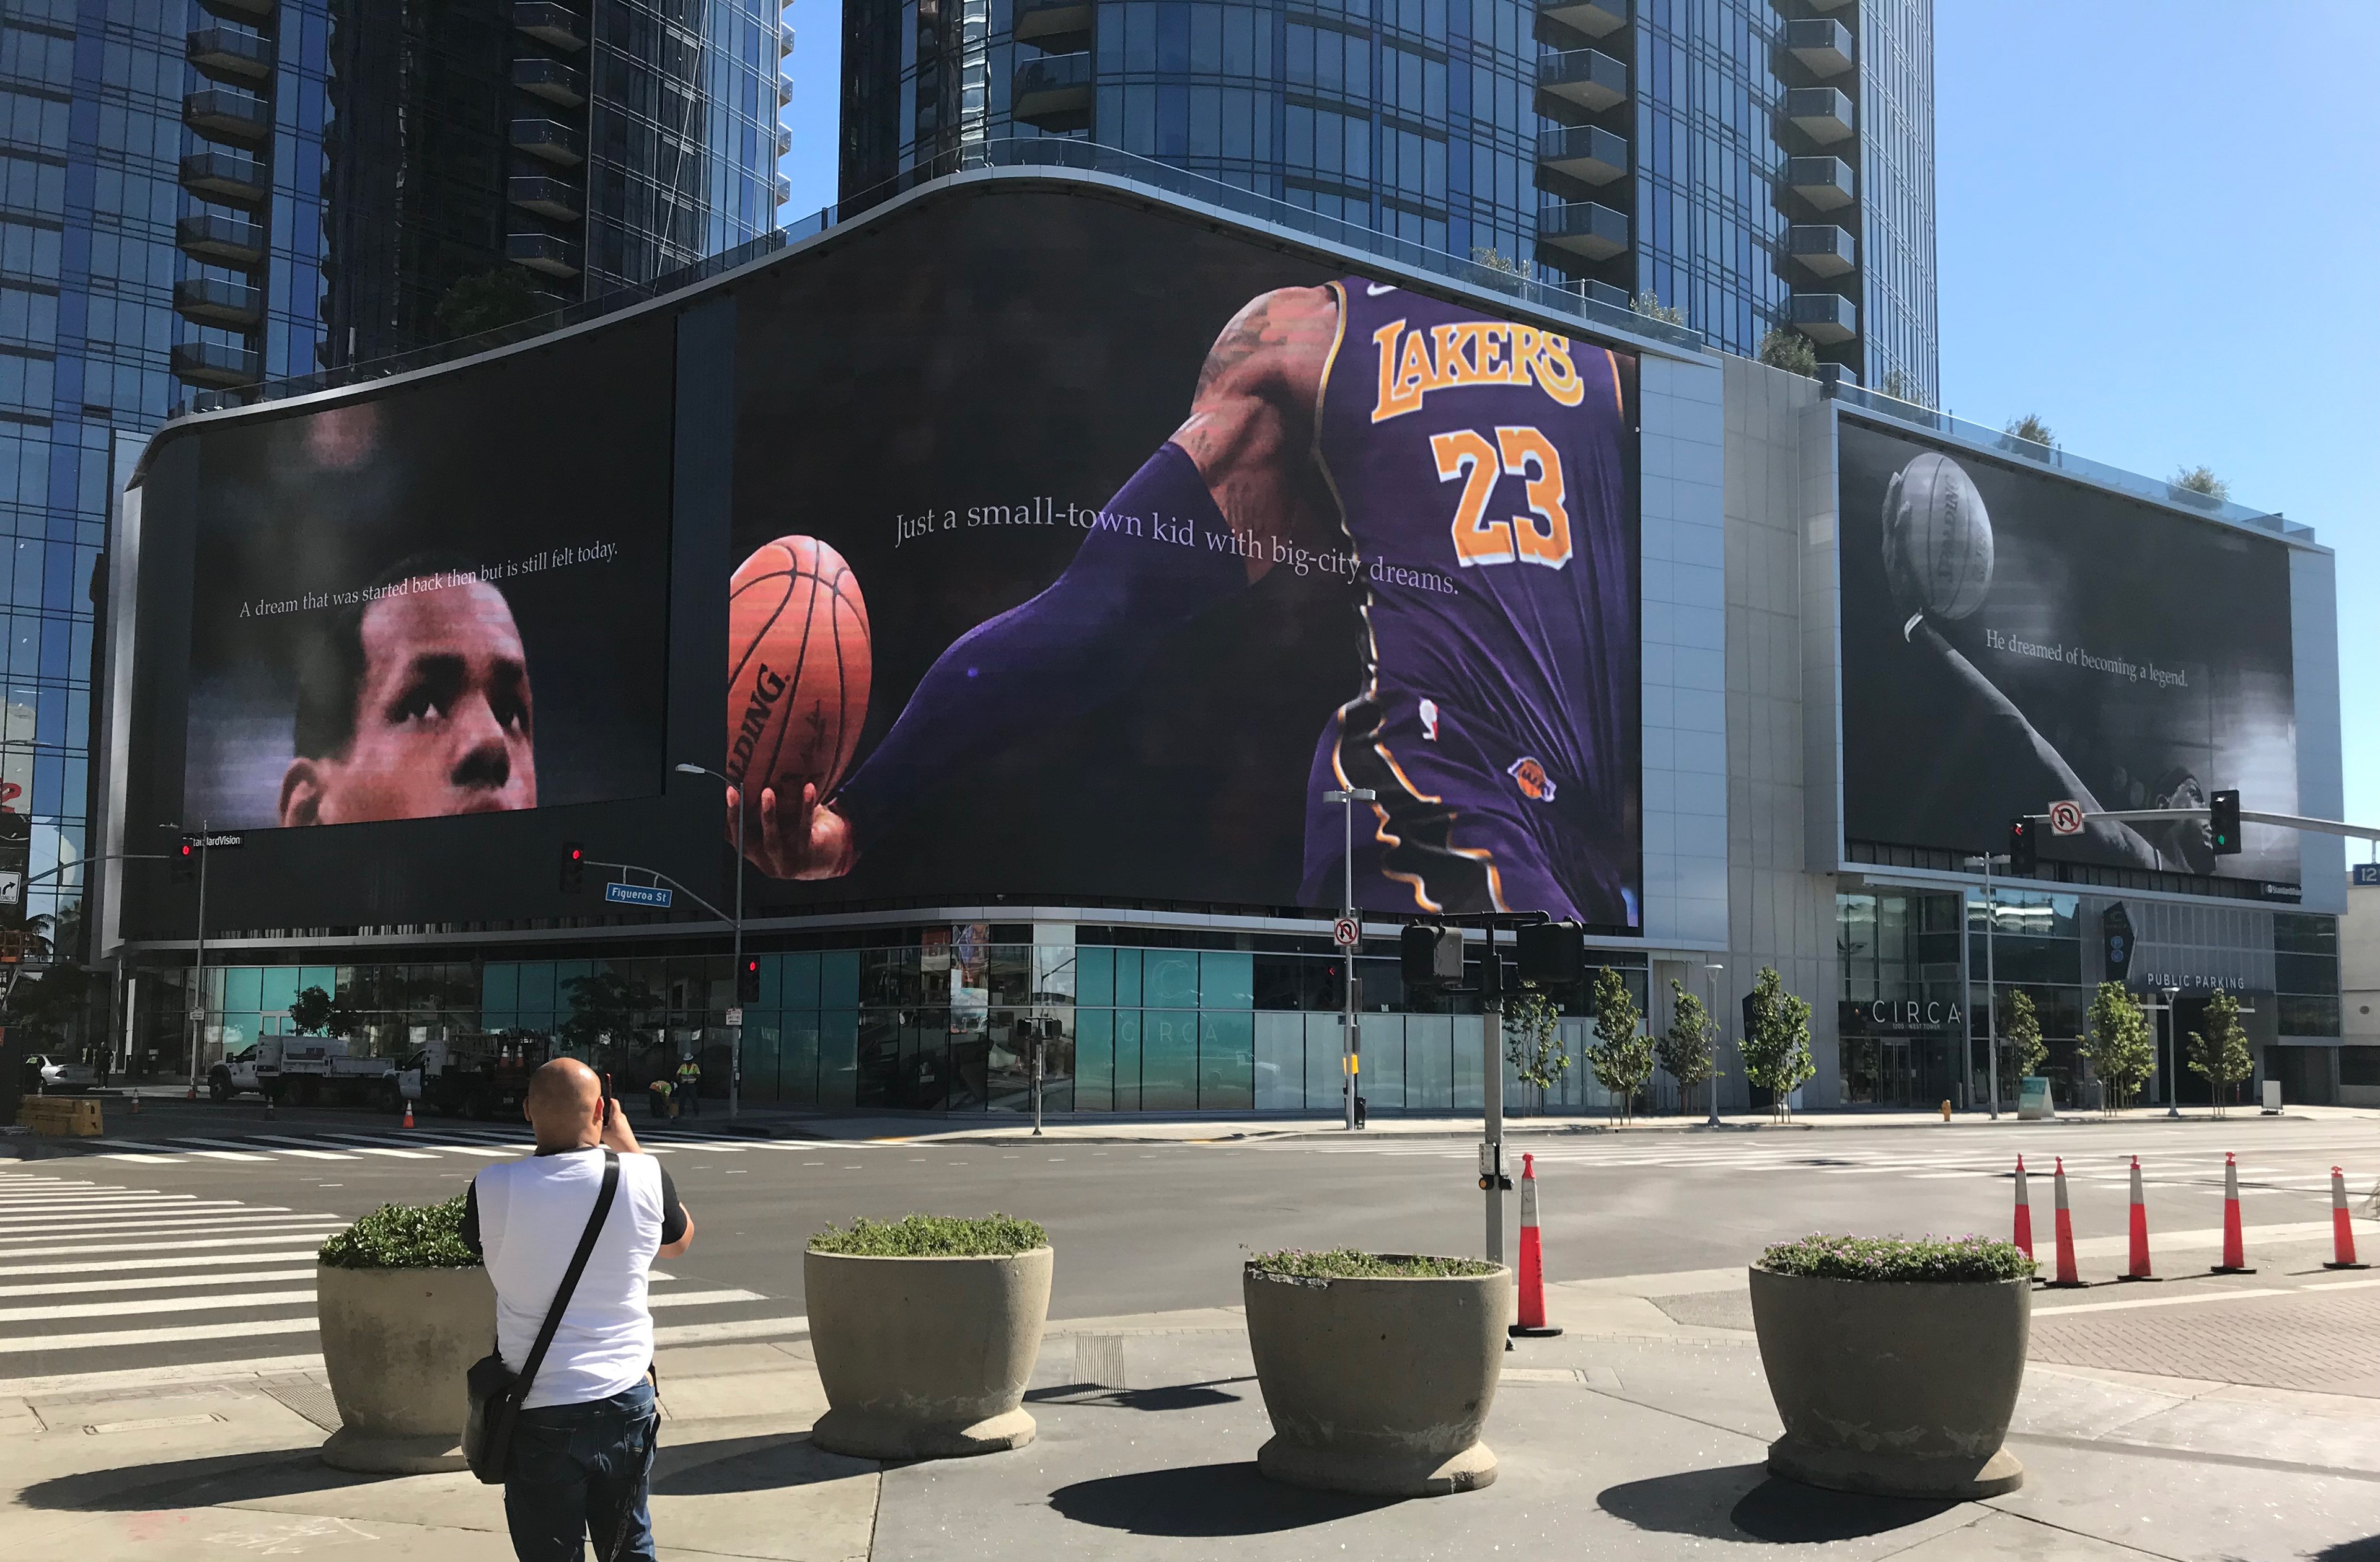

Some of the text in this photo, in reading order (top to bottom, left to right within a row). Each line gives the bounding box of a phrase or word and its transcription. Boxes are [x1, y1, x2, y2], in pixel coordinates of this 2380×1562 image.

[1372, 318, 1584, 424] LAKERS
[1429, 426, 1573, 571] 23
[895, 496, 1459, 595] Just a small-town kid with big-city dreams.
[239, 540, 618, 618] A dream that was started back then but is still felt today.
[1986, 628, 2188, 688] He dreamed of becoming a legend.
[611, 887, 666, 902] Figueroa St
[2148, 973, 2244, 989] PUBLIC PARKING
[1122, 1022, 1218, 1043] CIRCA
[1872, 1000, 1960, 1024] CIRCA
